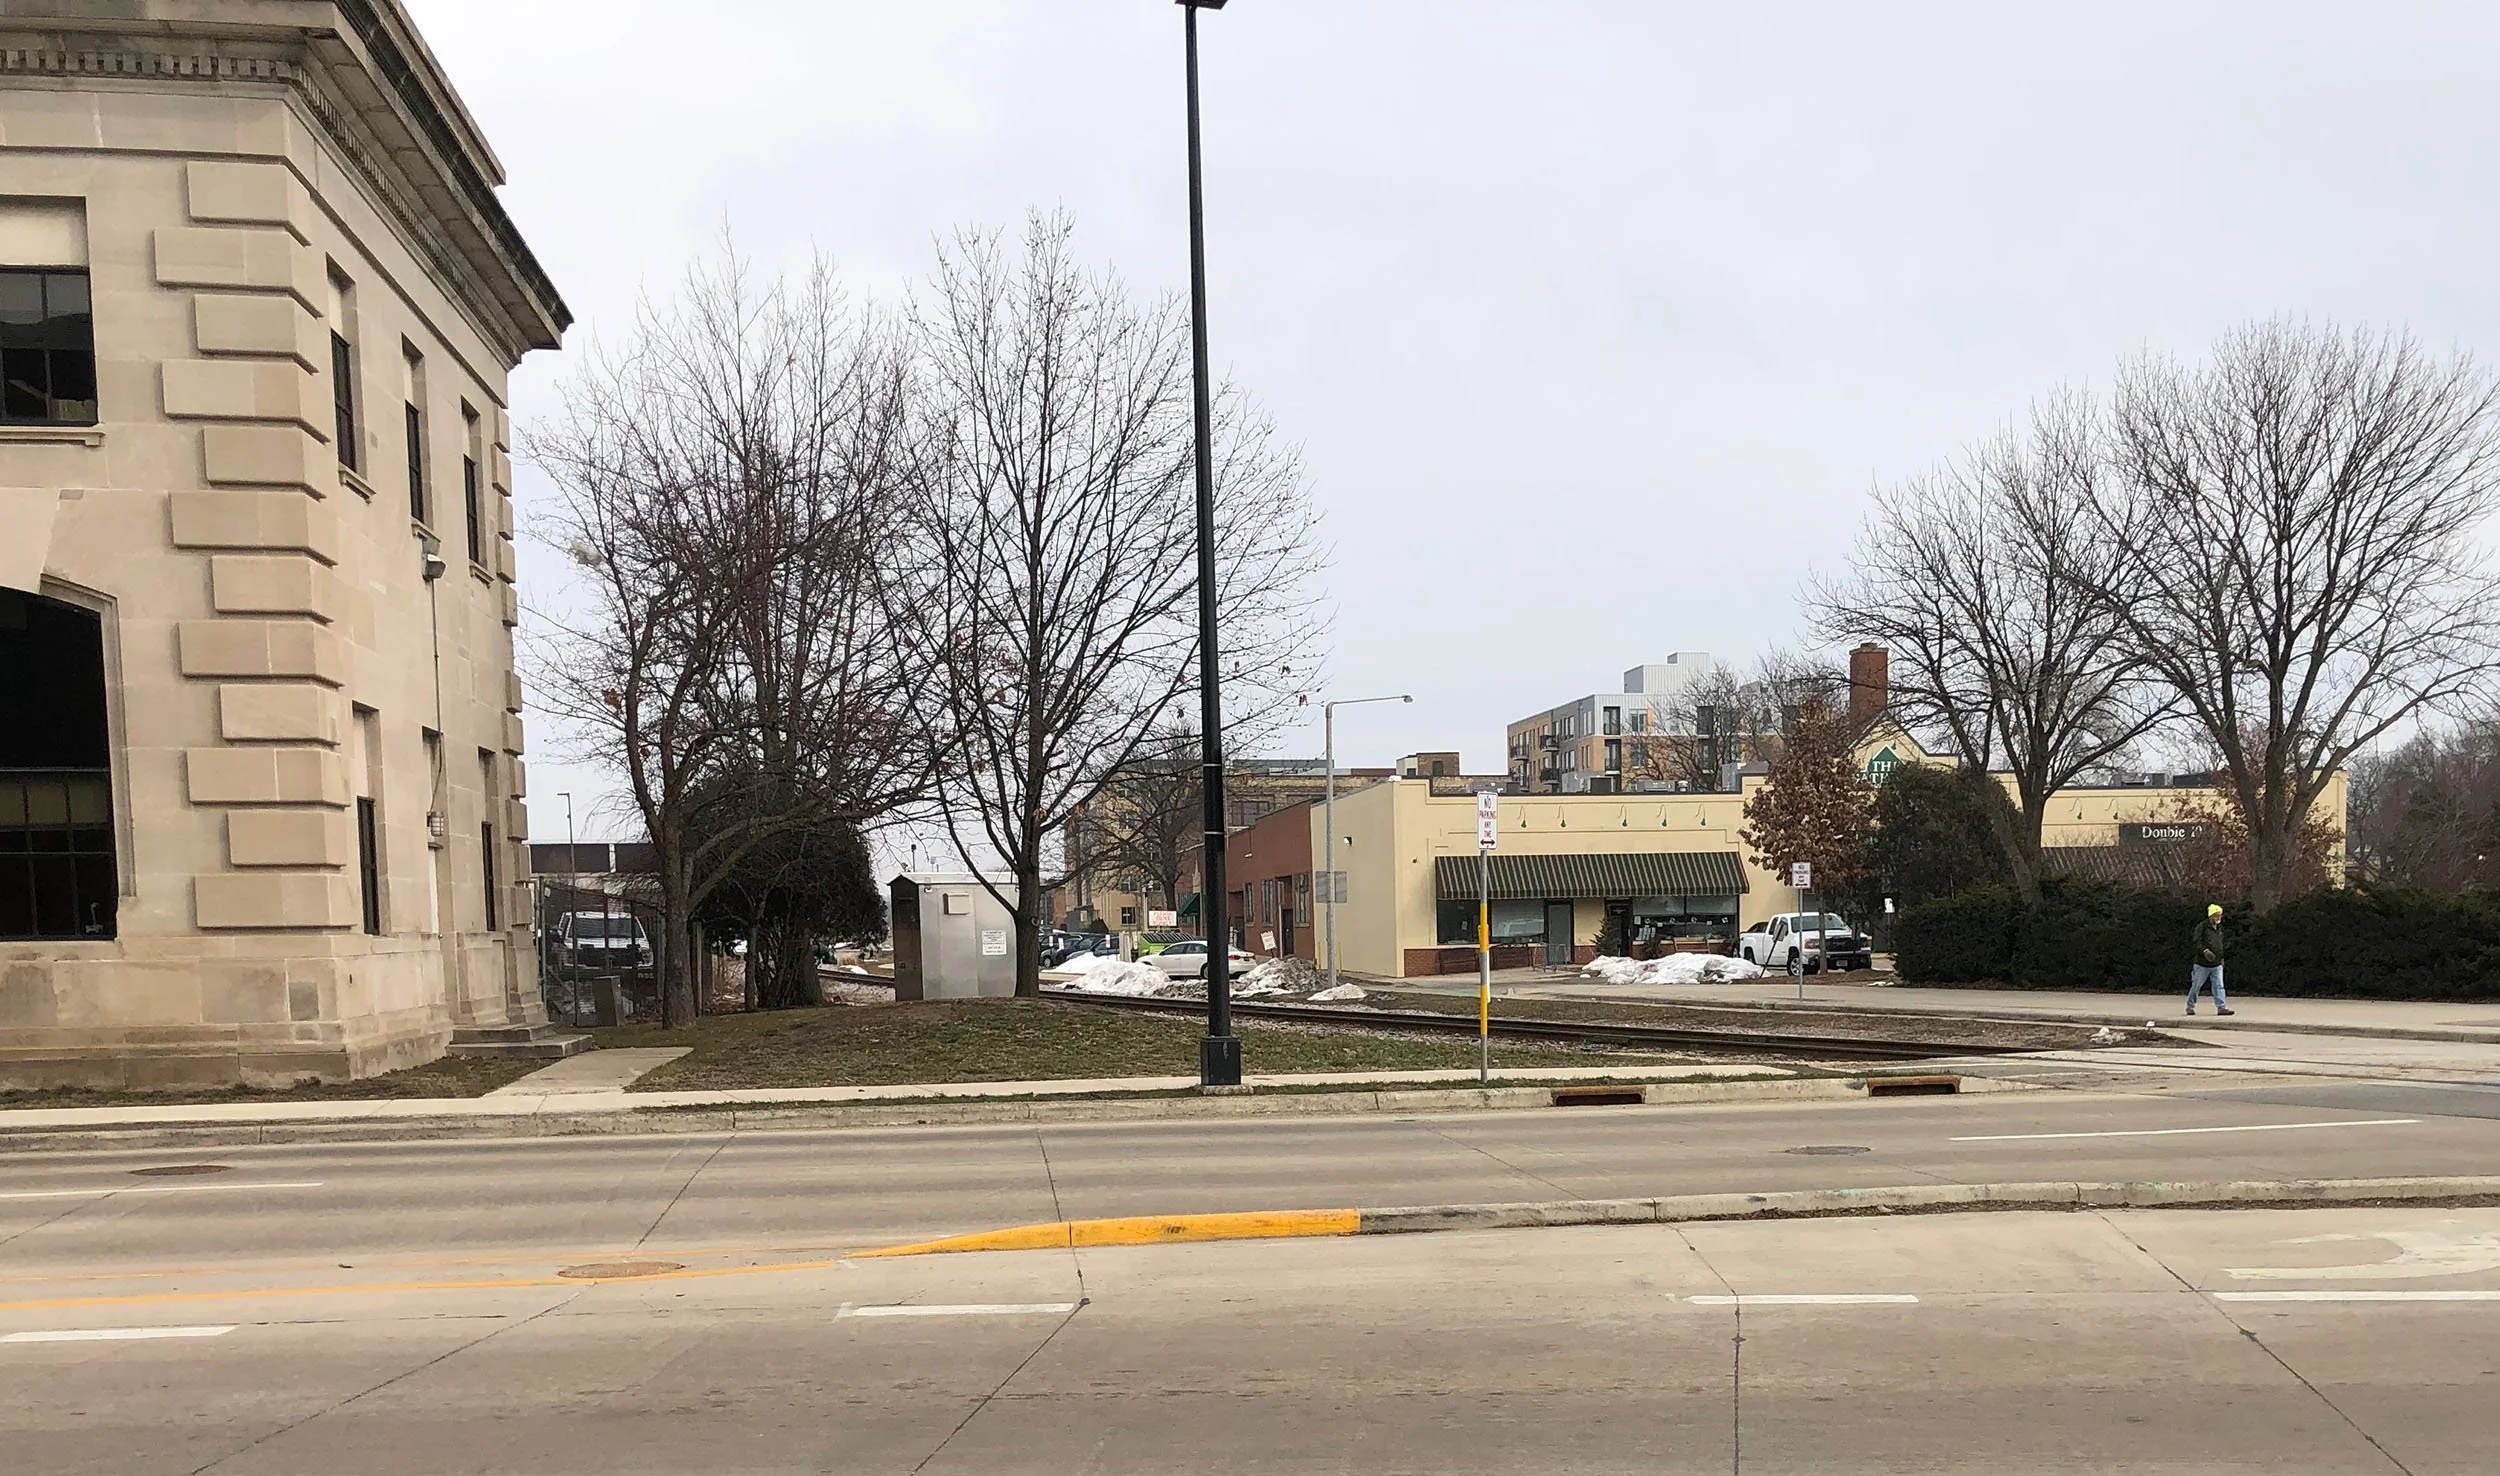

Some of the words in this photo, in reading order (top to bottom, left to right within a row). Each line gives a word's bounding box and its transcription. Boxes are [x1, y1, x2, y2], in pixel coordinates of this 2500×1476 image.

[1484, 798, 1492, 809] NO
[1479, 810, 1496, 820] PARKING
[2142, 826, 2185, 838] Double
